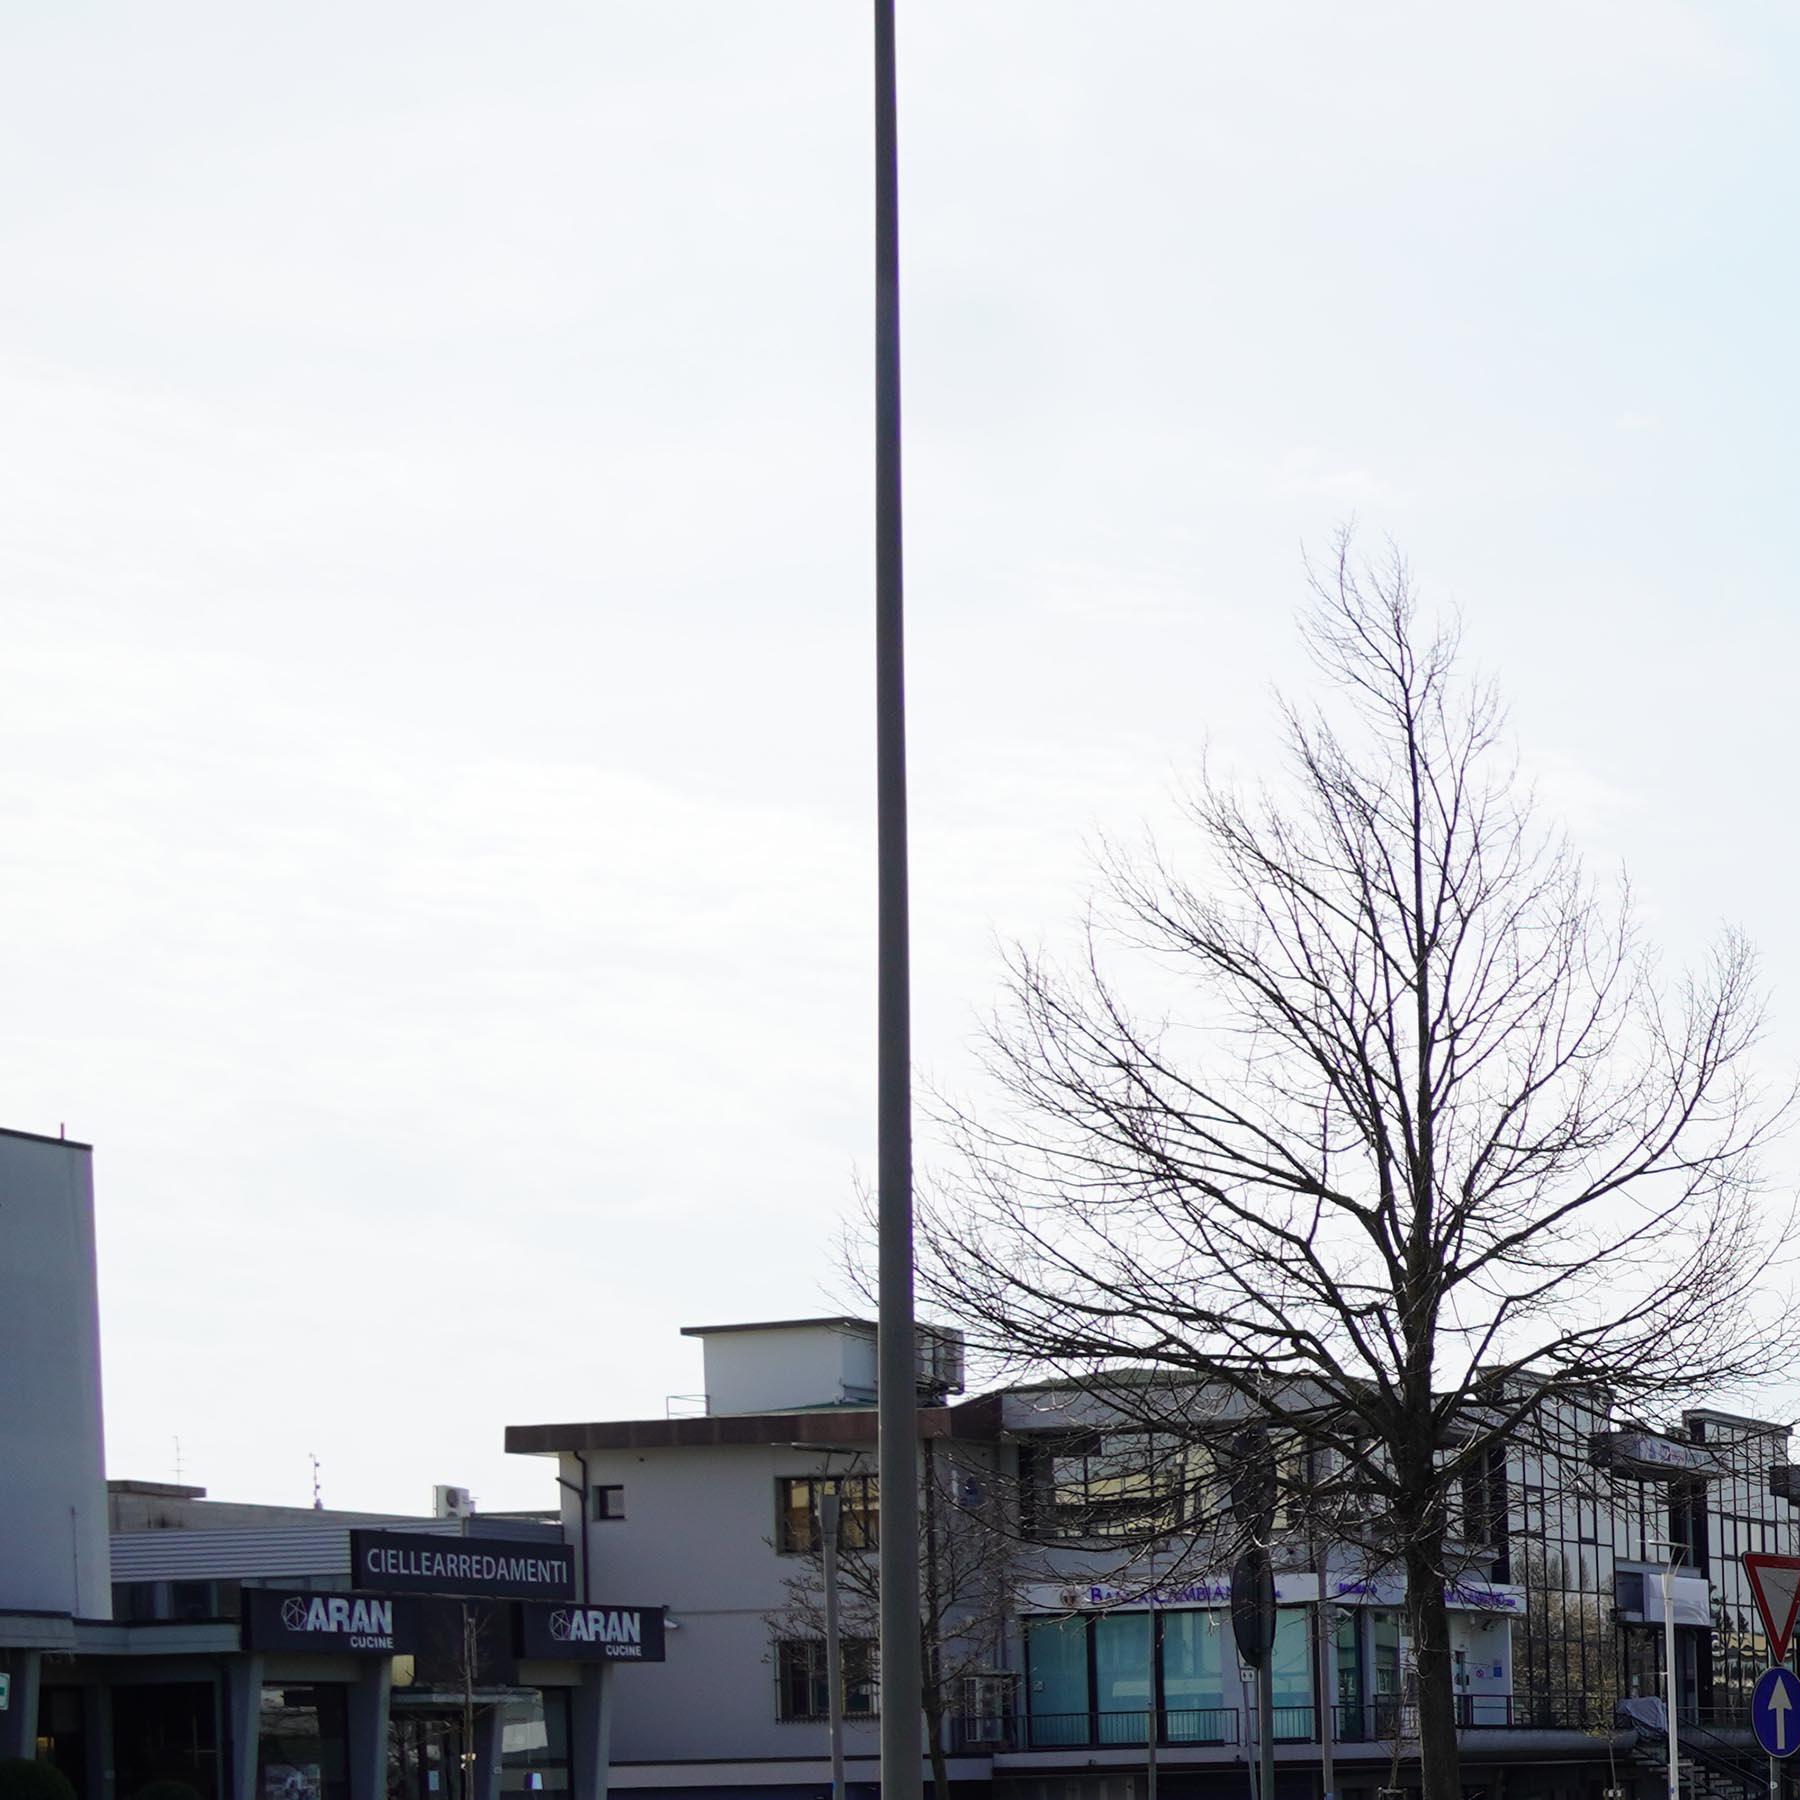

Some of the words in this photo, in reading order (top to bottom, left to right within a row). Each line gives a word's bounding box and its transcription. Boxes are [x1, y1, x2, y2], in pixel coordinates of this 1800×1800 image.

[367, 1548, 568, 1583] CIELLEARREDAMENTI
[306, 1597, 393, 1634] ARAN
[569, 1610, 641, 1643] ARAN
[350, 1636, 394, 1649] CUCINE
[606, 1645, 642, 1656] CUCINE
